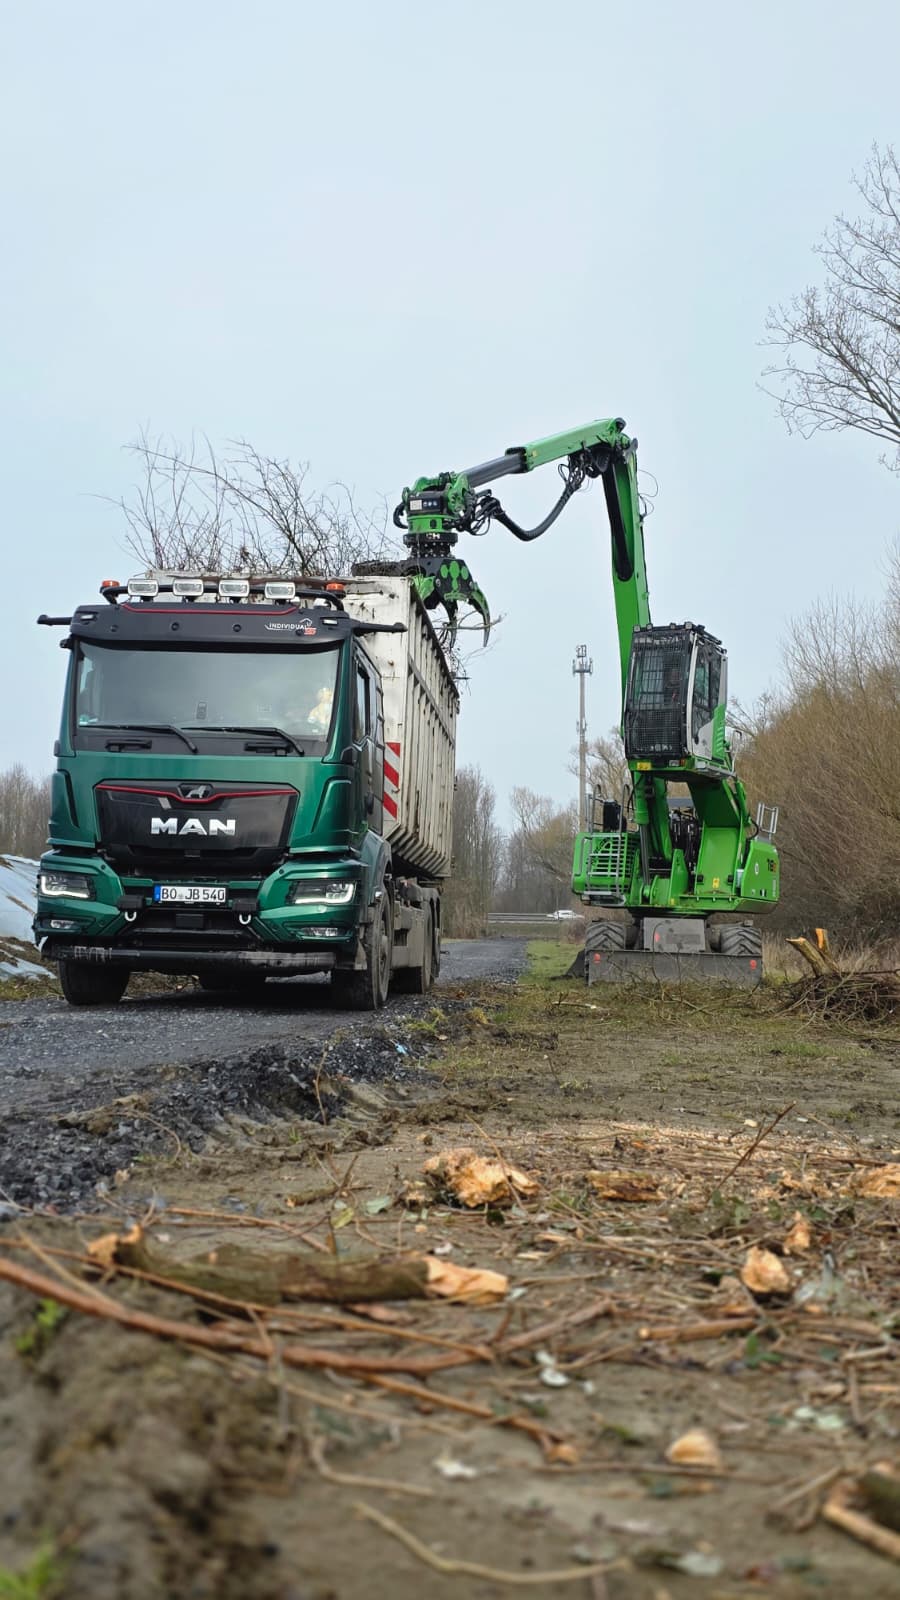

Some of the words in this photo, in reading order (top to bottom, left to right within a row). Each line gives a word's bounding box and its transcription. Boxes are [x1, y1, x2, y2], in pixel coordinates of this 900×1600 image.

[151, 817, 236, 836] MAN
[161, 888, 177, 900] BO
[185, 888, 200, 900] JB
[202, 888, 225, 901] 540
